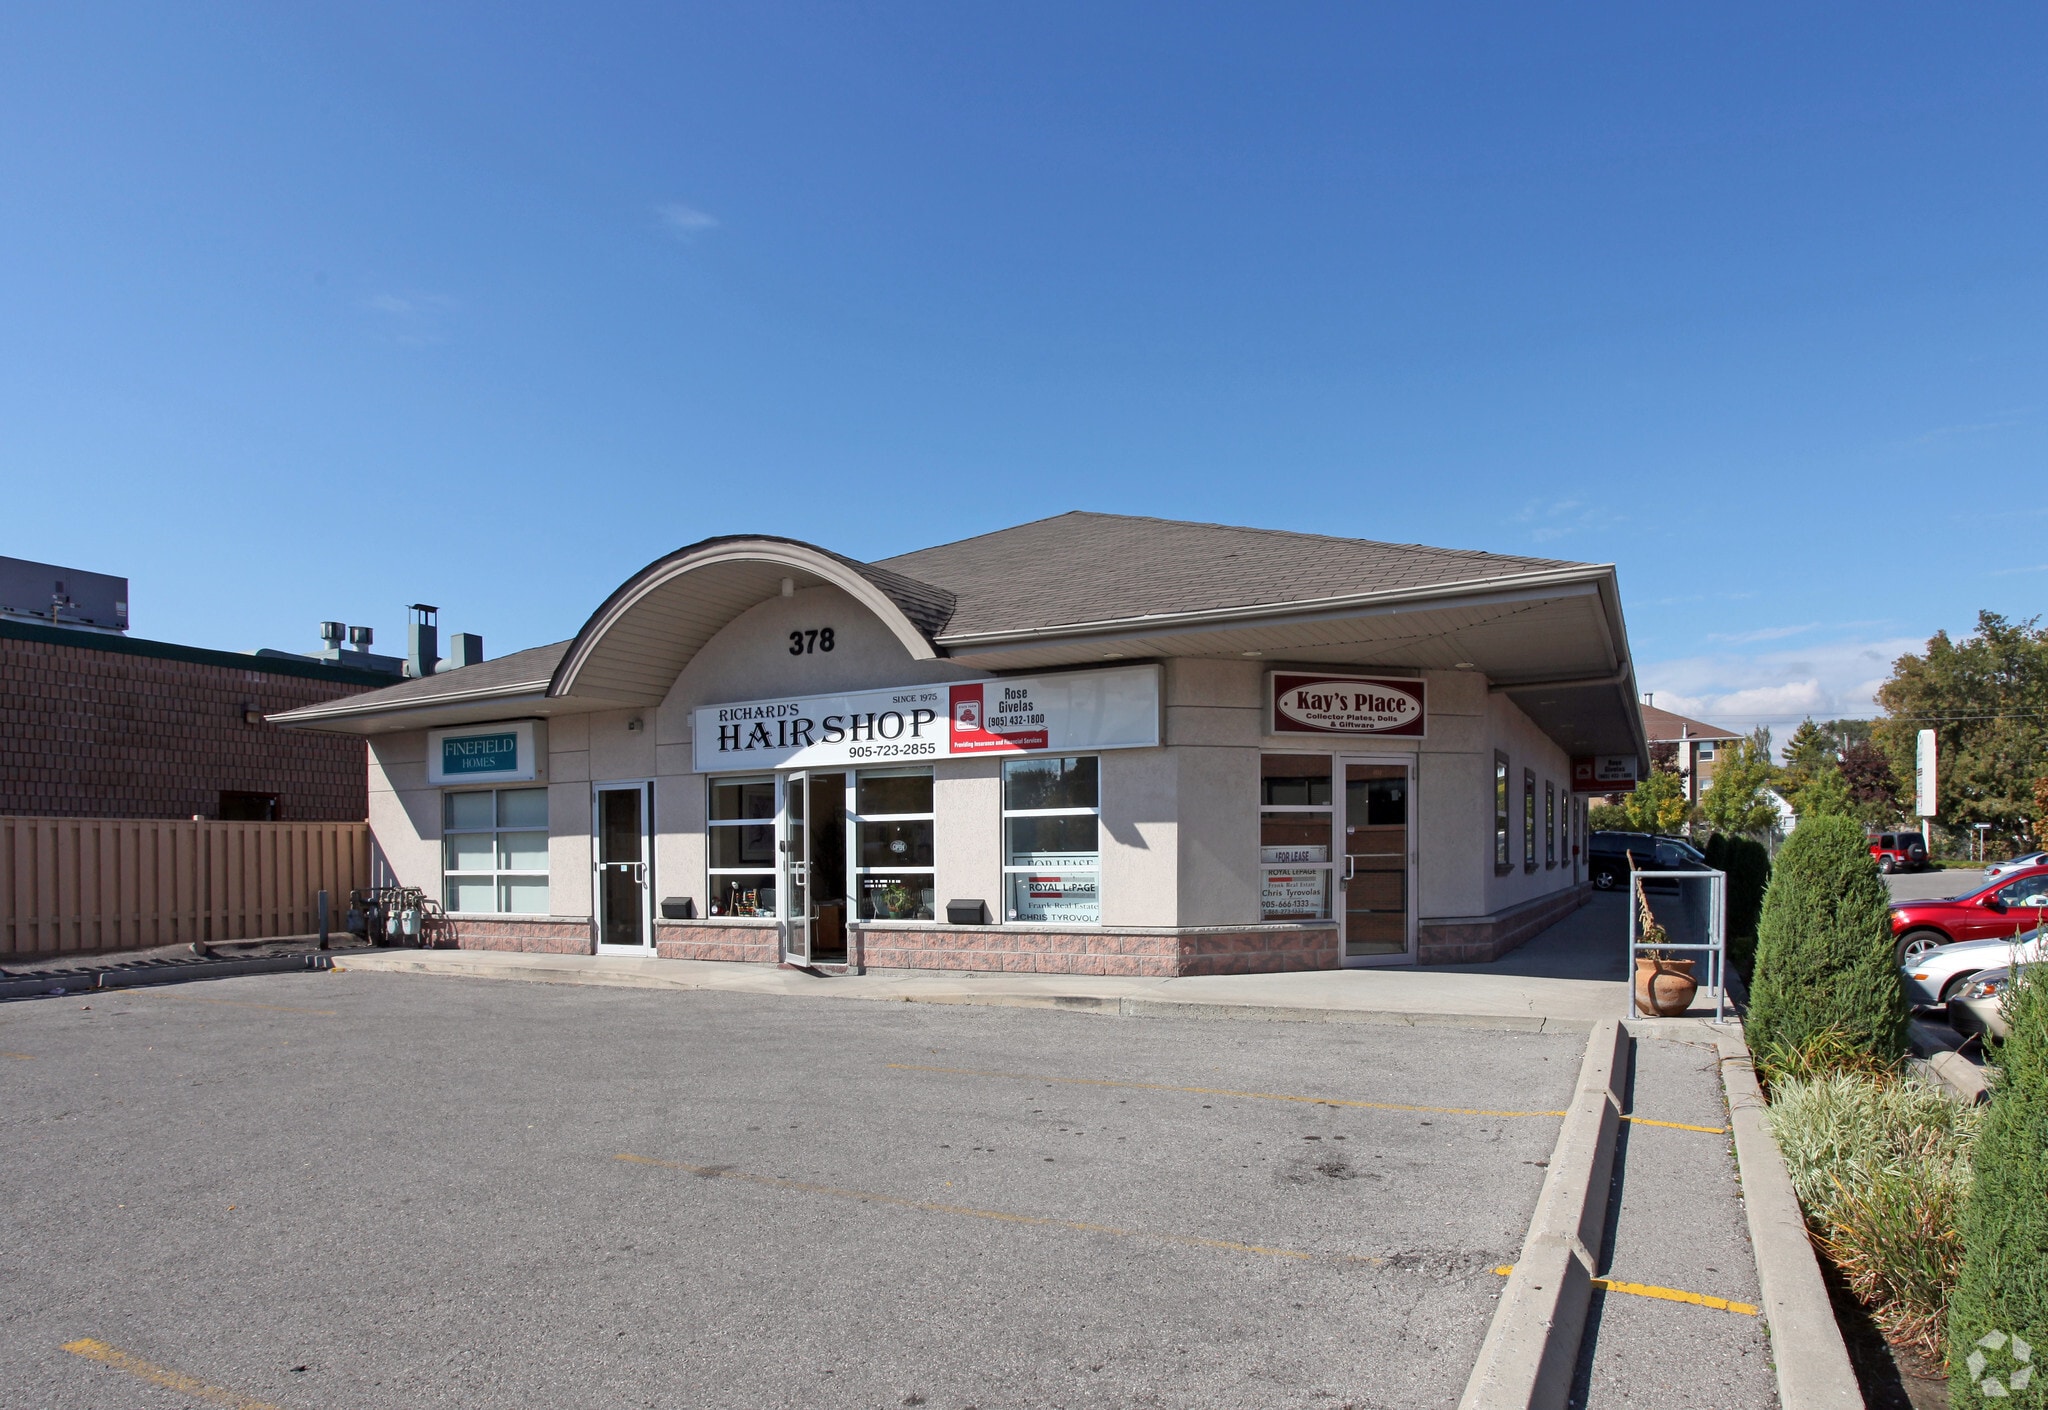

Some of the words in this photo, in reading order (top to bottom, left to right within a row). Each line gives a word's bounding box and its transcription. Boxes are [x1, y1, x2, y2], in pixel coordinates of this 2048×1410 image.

[789, 628, 835, 656] 378
[892, 694, 916, 704] SINCE
[919, 693, 938, 702] 1975
[1005, 688, 1028, 699] Rose
[999, 700, 1034, 713] Givelas
[1297, 691, 1348, 712] Kay's
[1354, 693, 1407, 713] Place
[719, 704, 799, 722] RICHARD'S
[988, 716, 1008, 728] (905)
[1009, 713, 1045, 725] 432-1800
[717, 708, 938, 752] HAIRSHOP
[445, 738, 514, 756] FINEFIELD
[849, 743, 936, 758] 905-723-2855
[463, 757, 496, 768] HOMES
[1291, 851, 1309, 861] LEASE
[1029, 883, 1060, 892] ROYAL
[1262, 889, 1282, 897] Chris
[1286, 888, 1320, 897] Tyrovolas
[1020, 913, 1048, 921] CHRIS
